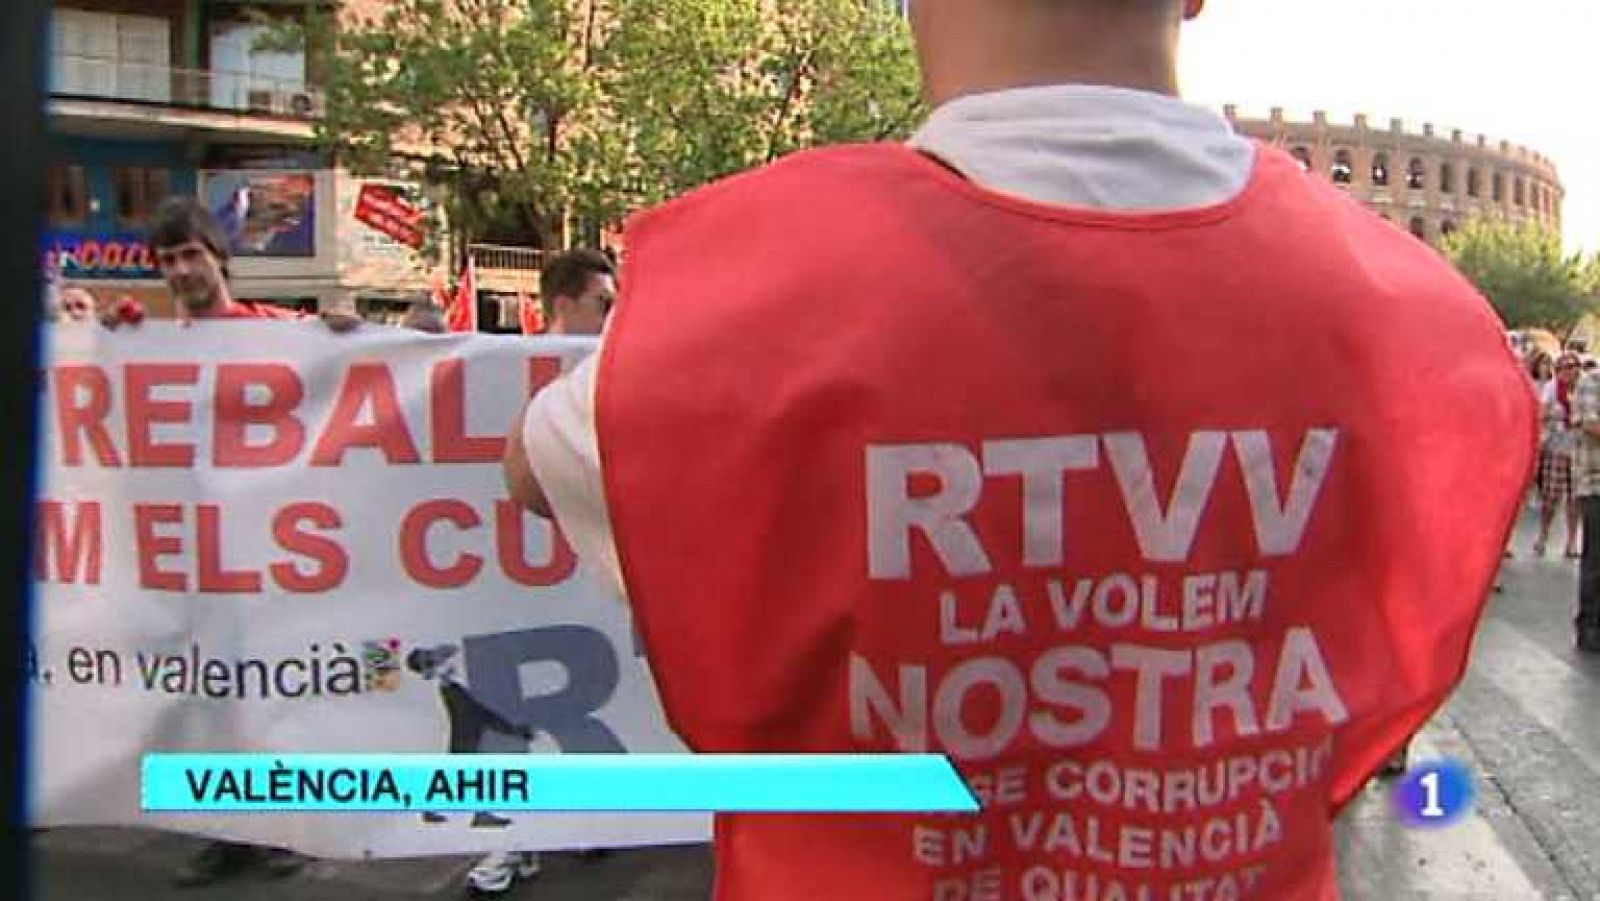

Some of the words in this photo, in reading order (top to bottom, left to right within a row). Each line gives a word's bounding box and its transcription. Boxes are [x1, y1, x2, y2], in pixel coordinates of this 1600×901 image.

[36, 356, 562, 468] REBAL
[134, 502, 349, 594] ELS
[865, 429, 1338, 580] RTVV
[938, 584, 1026, 645] LA
[1046, 570, 1268, 632] VOLEM
[67, 646, 121, 686] en
[137, 641, 362, 699] valencià
[848, 624, 1350, 760] NOSTRA
[912, 824, 986, 865] EN
[1009, 797, 1281, 869] VALENCIÀ
